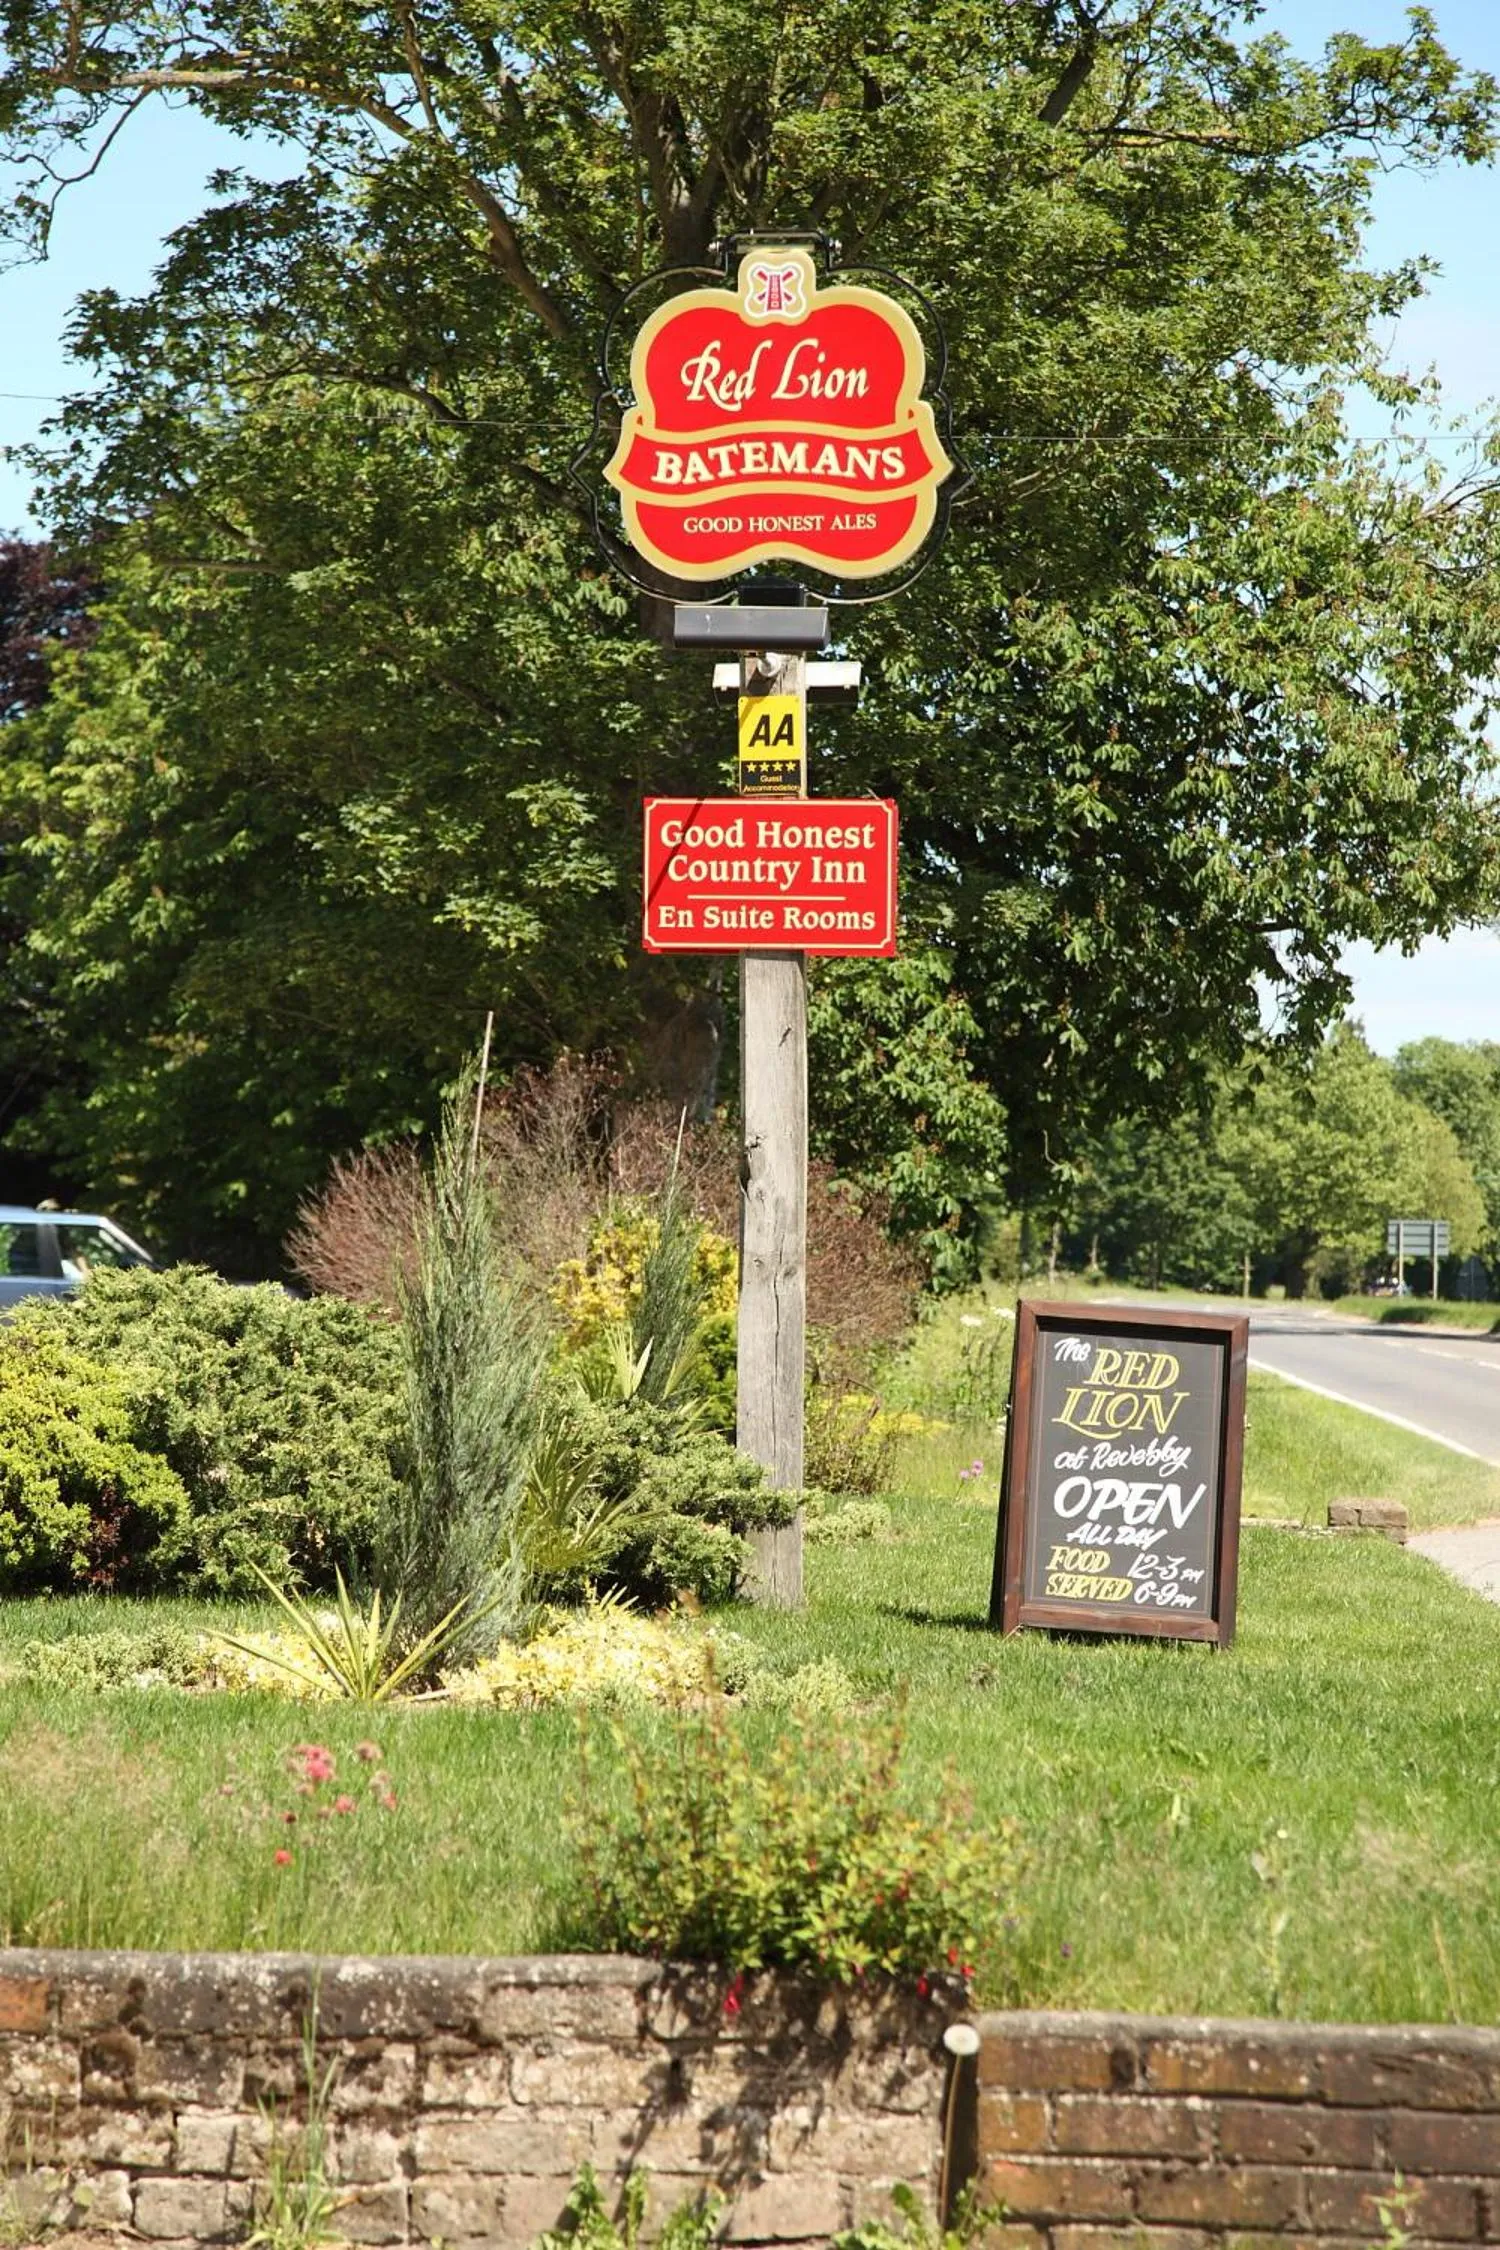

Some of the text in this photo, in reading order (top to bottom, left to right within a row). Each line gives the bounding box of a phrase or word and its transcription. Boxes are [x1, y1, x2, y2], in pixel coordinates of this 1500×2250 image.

[680, 338, 870, 412] Red Lion
[650, 441, 906, 485] BATEMANS
[683, 513, 877, 533] GOOD HONEST ALES
[748, 713, 794, 748] AA
[660, 818, 876, 849] Good Honest
[667, 854, 867, 891] Country Inn
[658, 905, 876, 930] En Suite Rooms
[1053, 1337, 1180, 1389] The RED
[1051, 1388, 1191, 1440] LION
[1054, 1446, 1089, 1470] at
[1053, 1476, 1207, 1529] OPEN
[1066, 1522, 1168, 1551] ALL DAY
[1045, 1546, 1110, 1573] FOOD
[1045, 1572, 1133, 1601] SERVED
